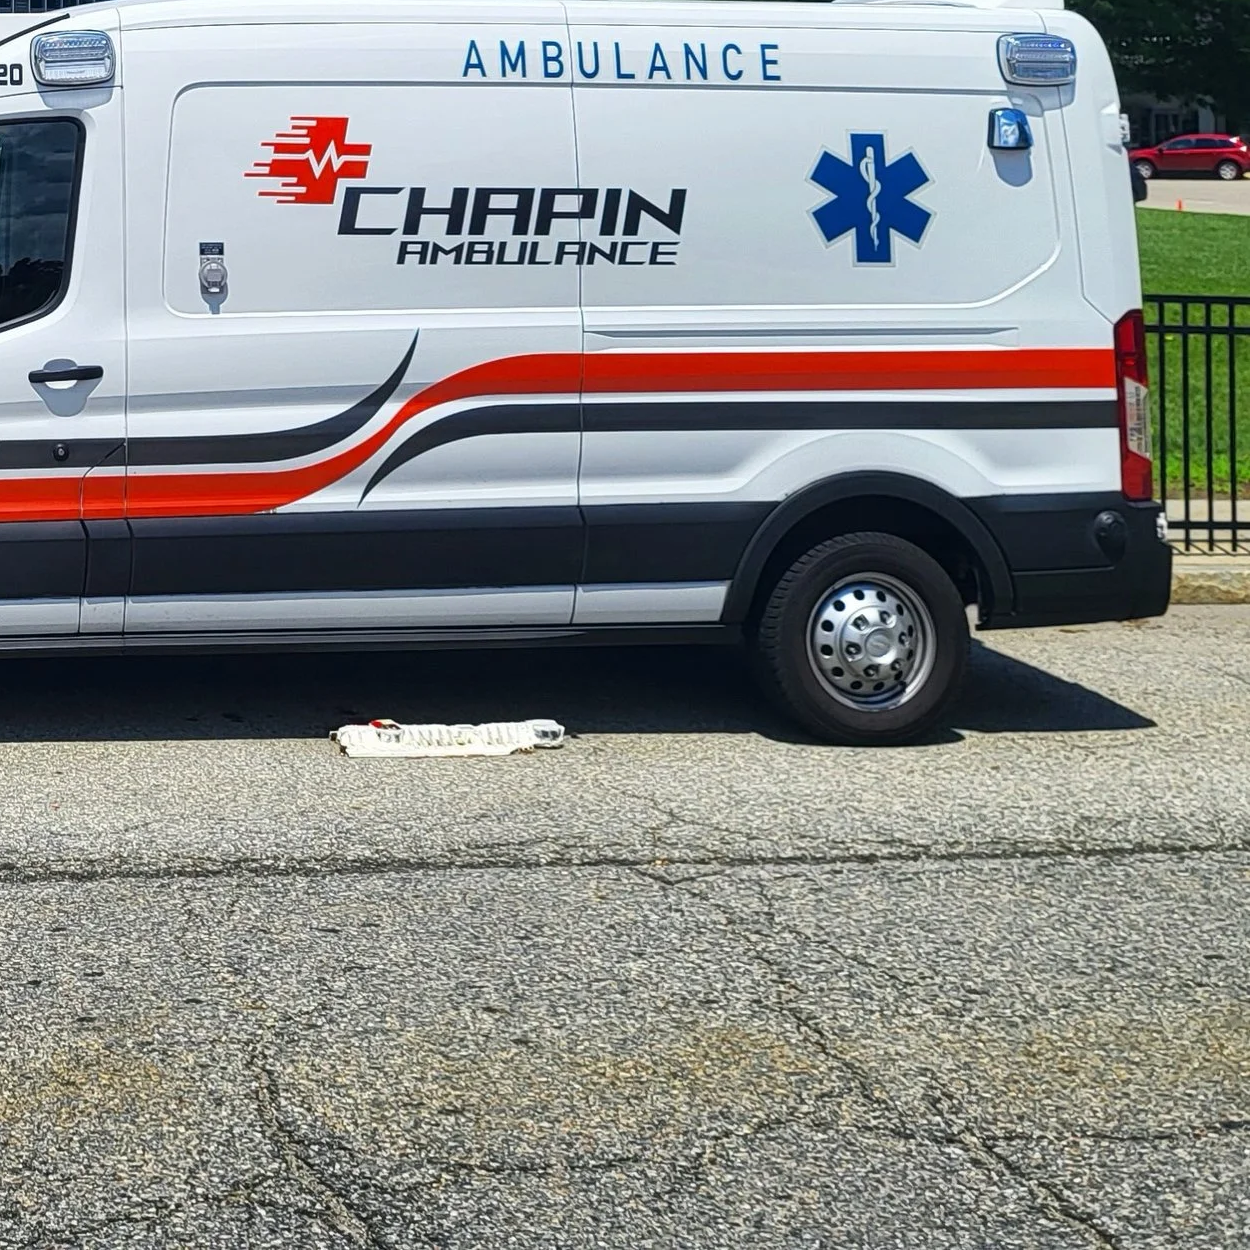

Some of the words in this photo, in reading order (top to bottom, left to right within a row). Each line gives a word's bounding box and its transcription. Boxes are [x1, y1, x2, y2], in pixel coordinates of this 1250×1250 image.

[462, 40, 782, 81] AMBULANCE
[337, 187, 688, 236] CHAPIN
[396, 241, 681, 265] AMBULANCE
